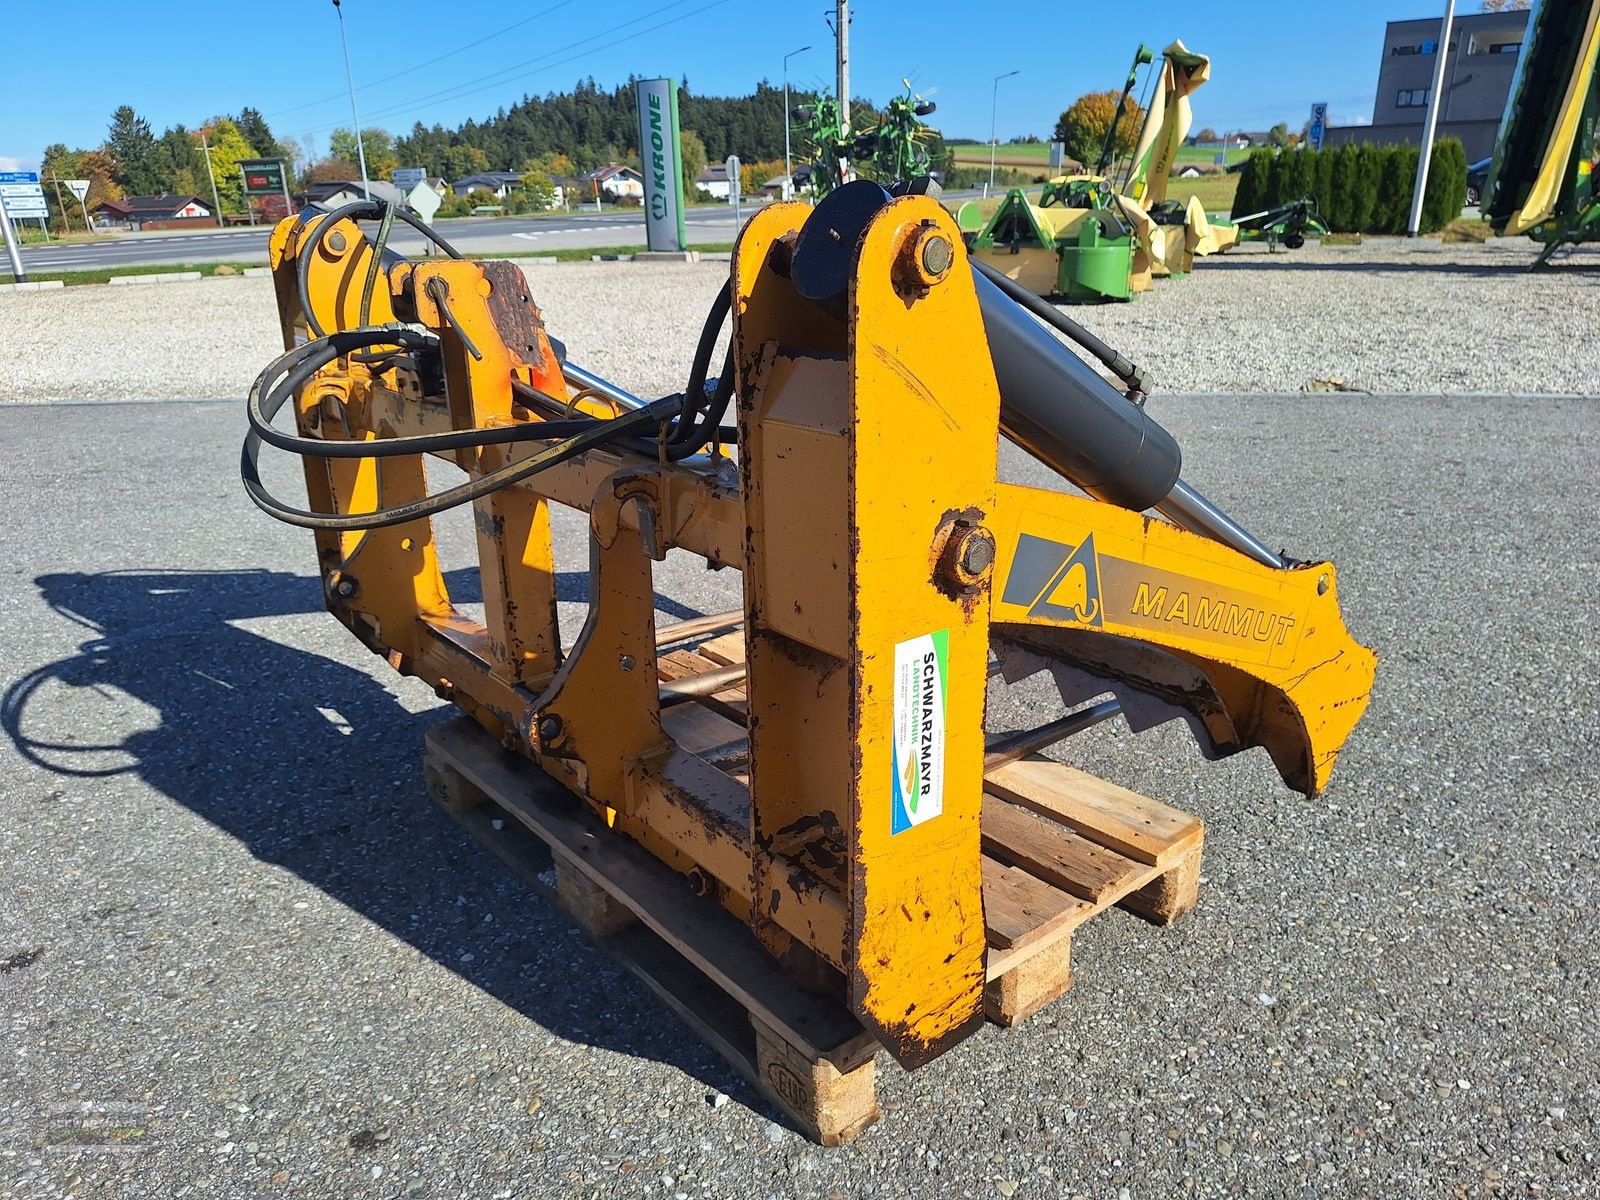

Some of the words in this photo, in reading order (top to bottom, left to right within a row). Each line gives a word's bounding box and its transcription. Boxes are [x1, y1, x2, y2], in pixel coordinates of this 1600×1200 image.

[648, 93, 666, 190] KRONE
[1131, 582, 1296, 646] MAMMUT
[911, 659, 921, 745] LANDTECHNIK
[921, 651, 935, 796] SCHWARZMAYR
